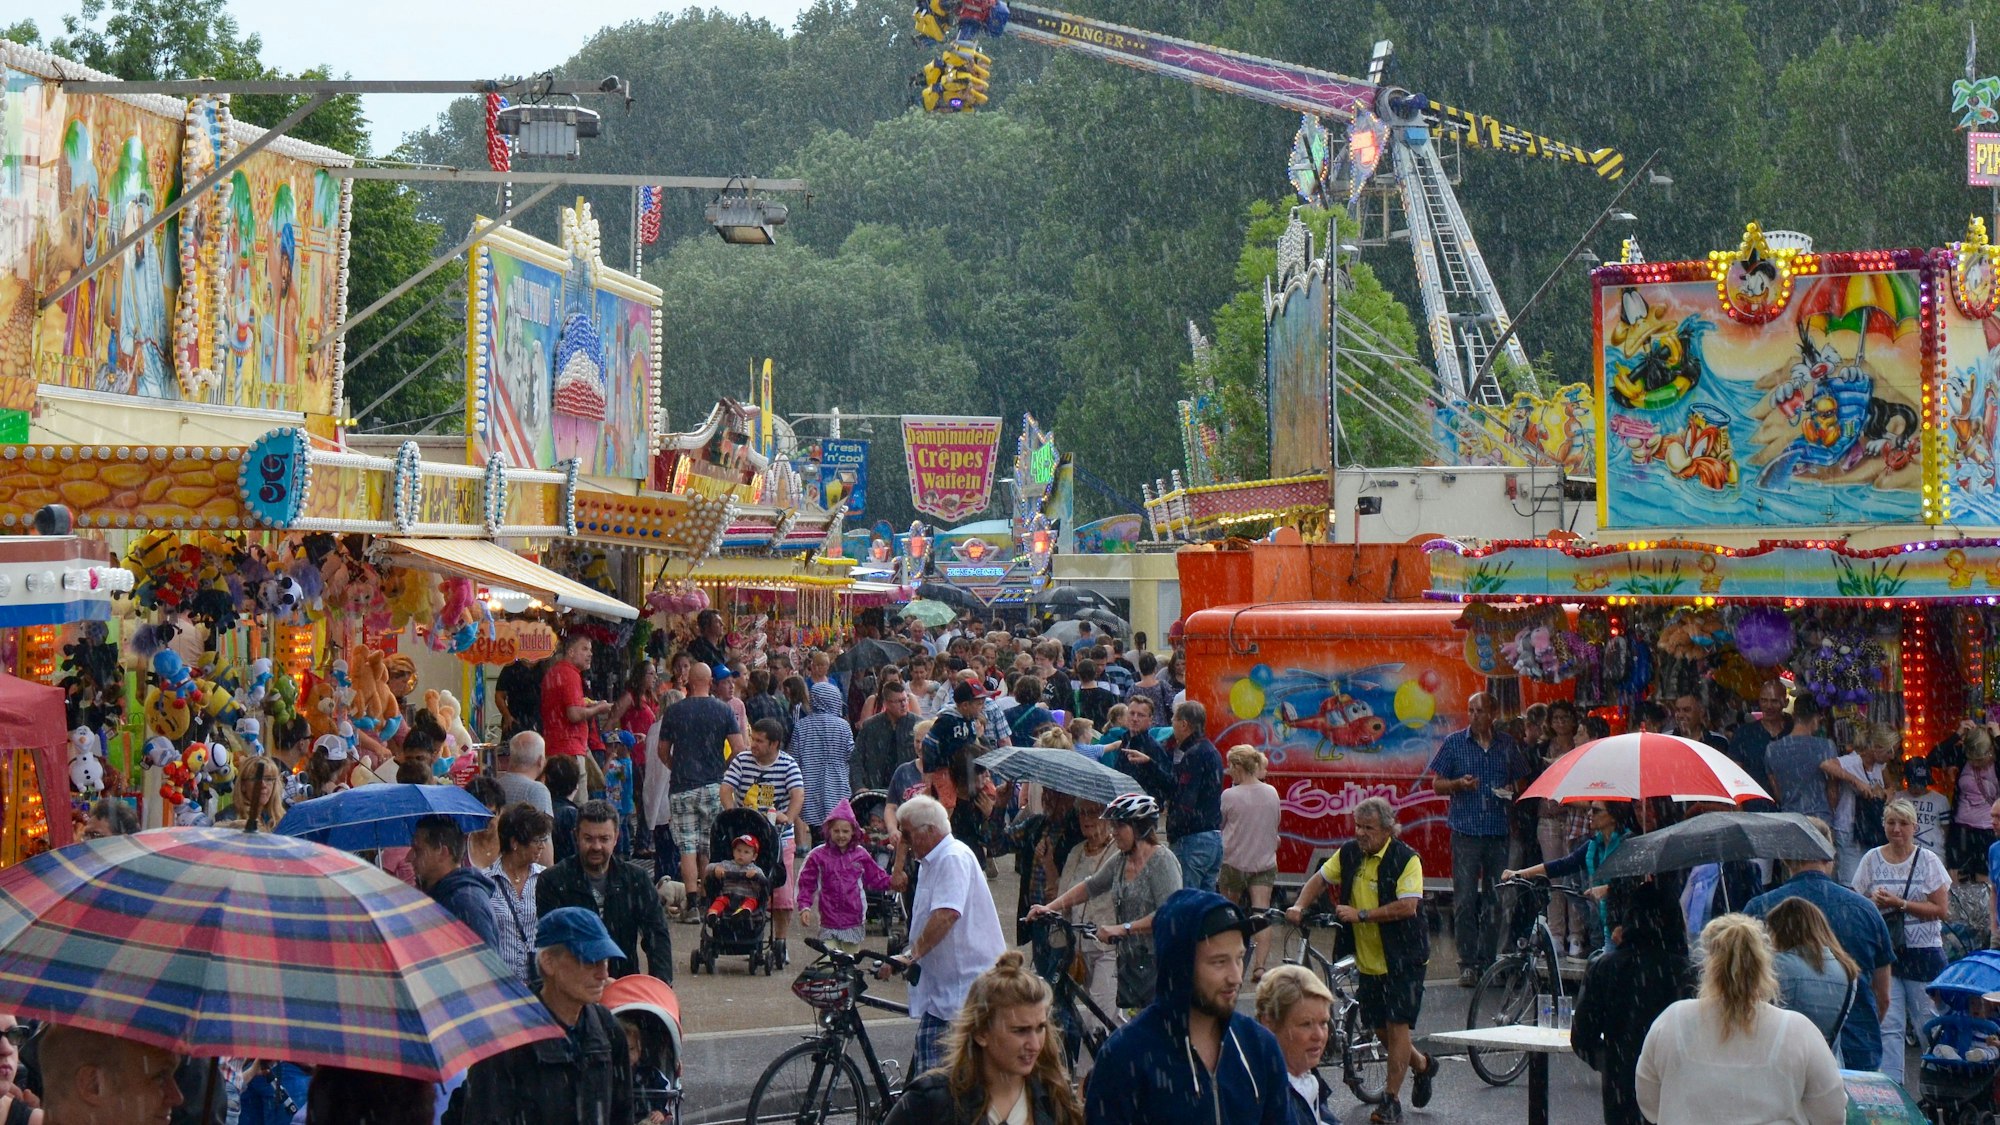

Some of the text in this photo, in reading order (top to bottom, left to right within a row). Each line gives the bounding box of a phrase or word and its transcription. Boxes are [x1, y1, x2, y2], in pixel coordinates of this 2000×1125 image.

[1059, 21, 1124, 48] DANGER
[828, 442, 861, 452] fresh
[918, 448, 983, 470] Crêpes
[472, 628, 515, 657] êpes
